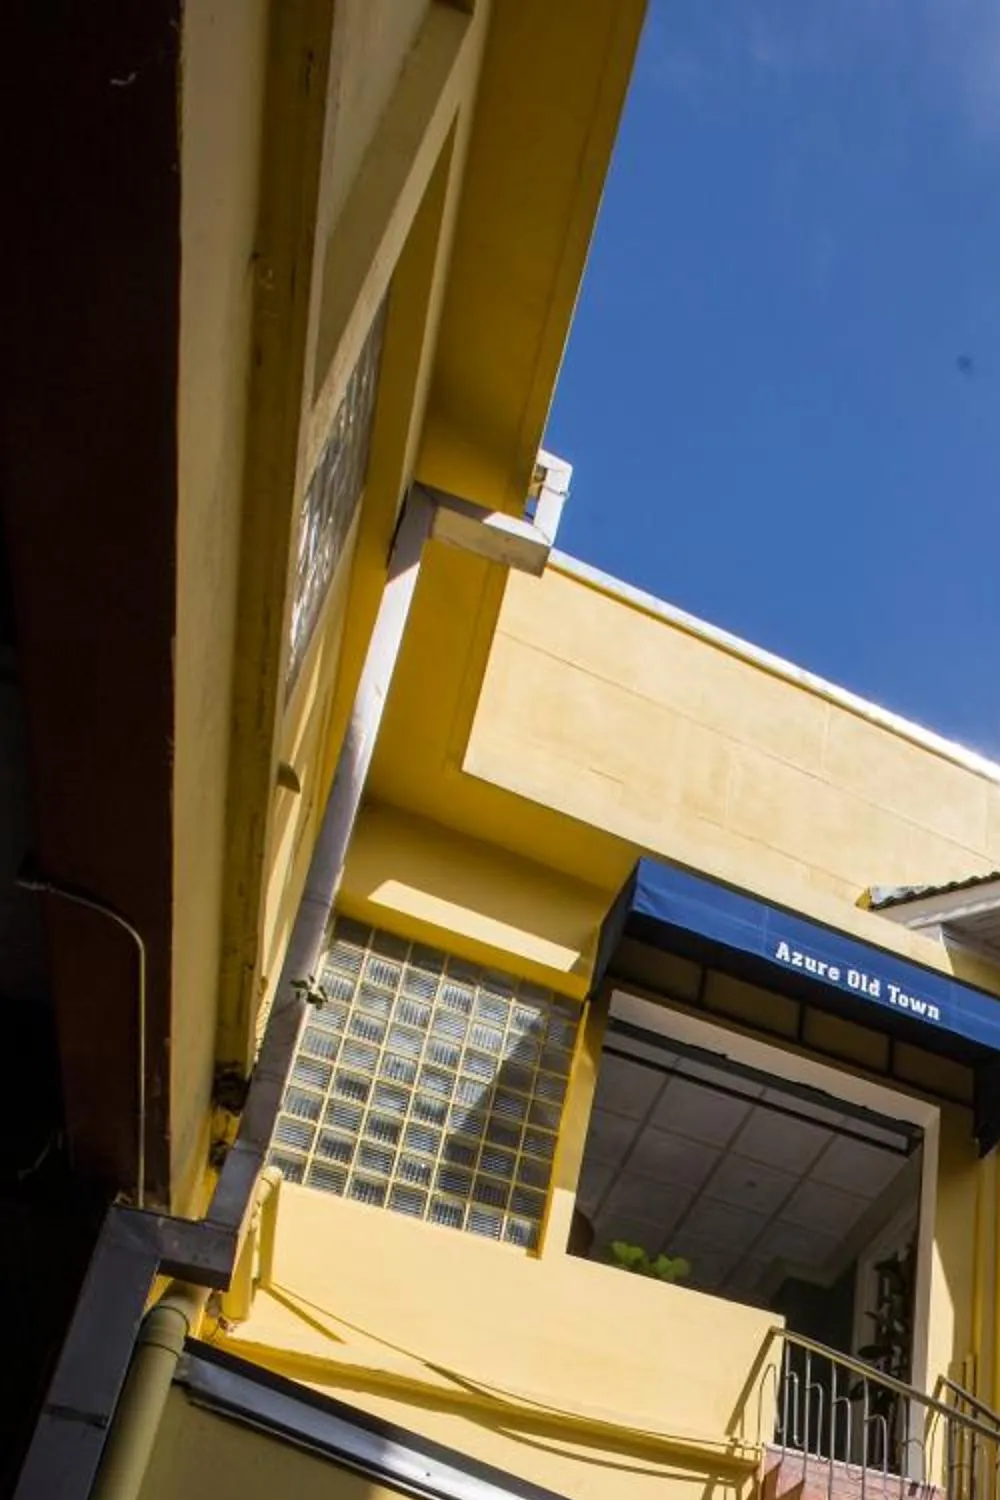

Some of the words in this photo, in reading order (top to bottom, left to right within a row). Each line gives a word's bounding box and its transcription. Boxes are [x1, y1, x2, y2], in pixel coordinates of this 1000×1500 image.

[775, 941, 840, 981] Azure
[847, 969, 881, 997] Old
[887, 984, 940, 1021] Town
